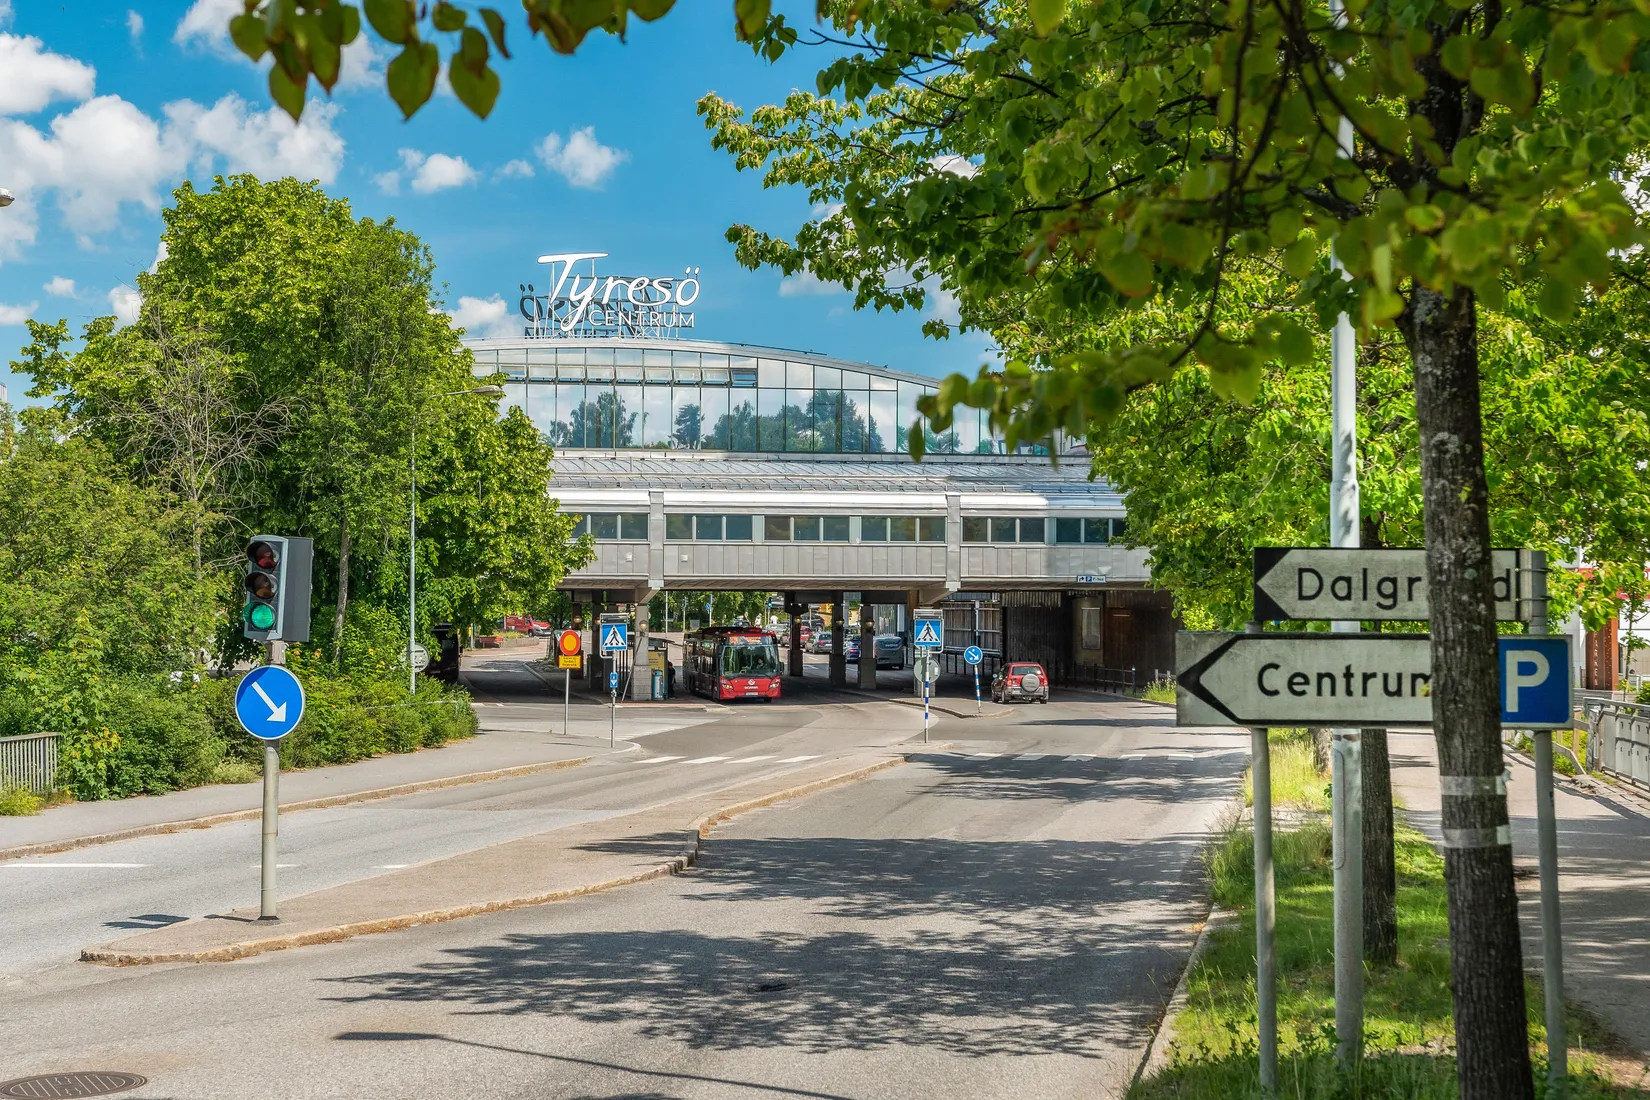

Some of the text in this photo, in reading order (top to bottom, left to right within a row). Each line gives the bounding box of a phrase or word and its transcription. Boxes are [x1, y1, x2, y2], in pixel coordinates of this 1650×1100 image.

[537, 252, 700, 332] Tyresö
[589, 309, 696, 328] CENTRUM
[1298, 567, 1511, 610] Dalgrd
[1504, 649, 1550, 713] P
